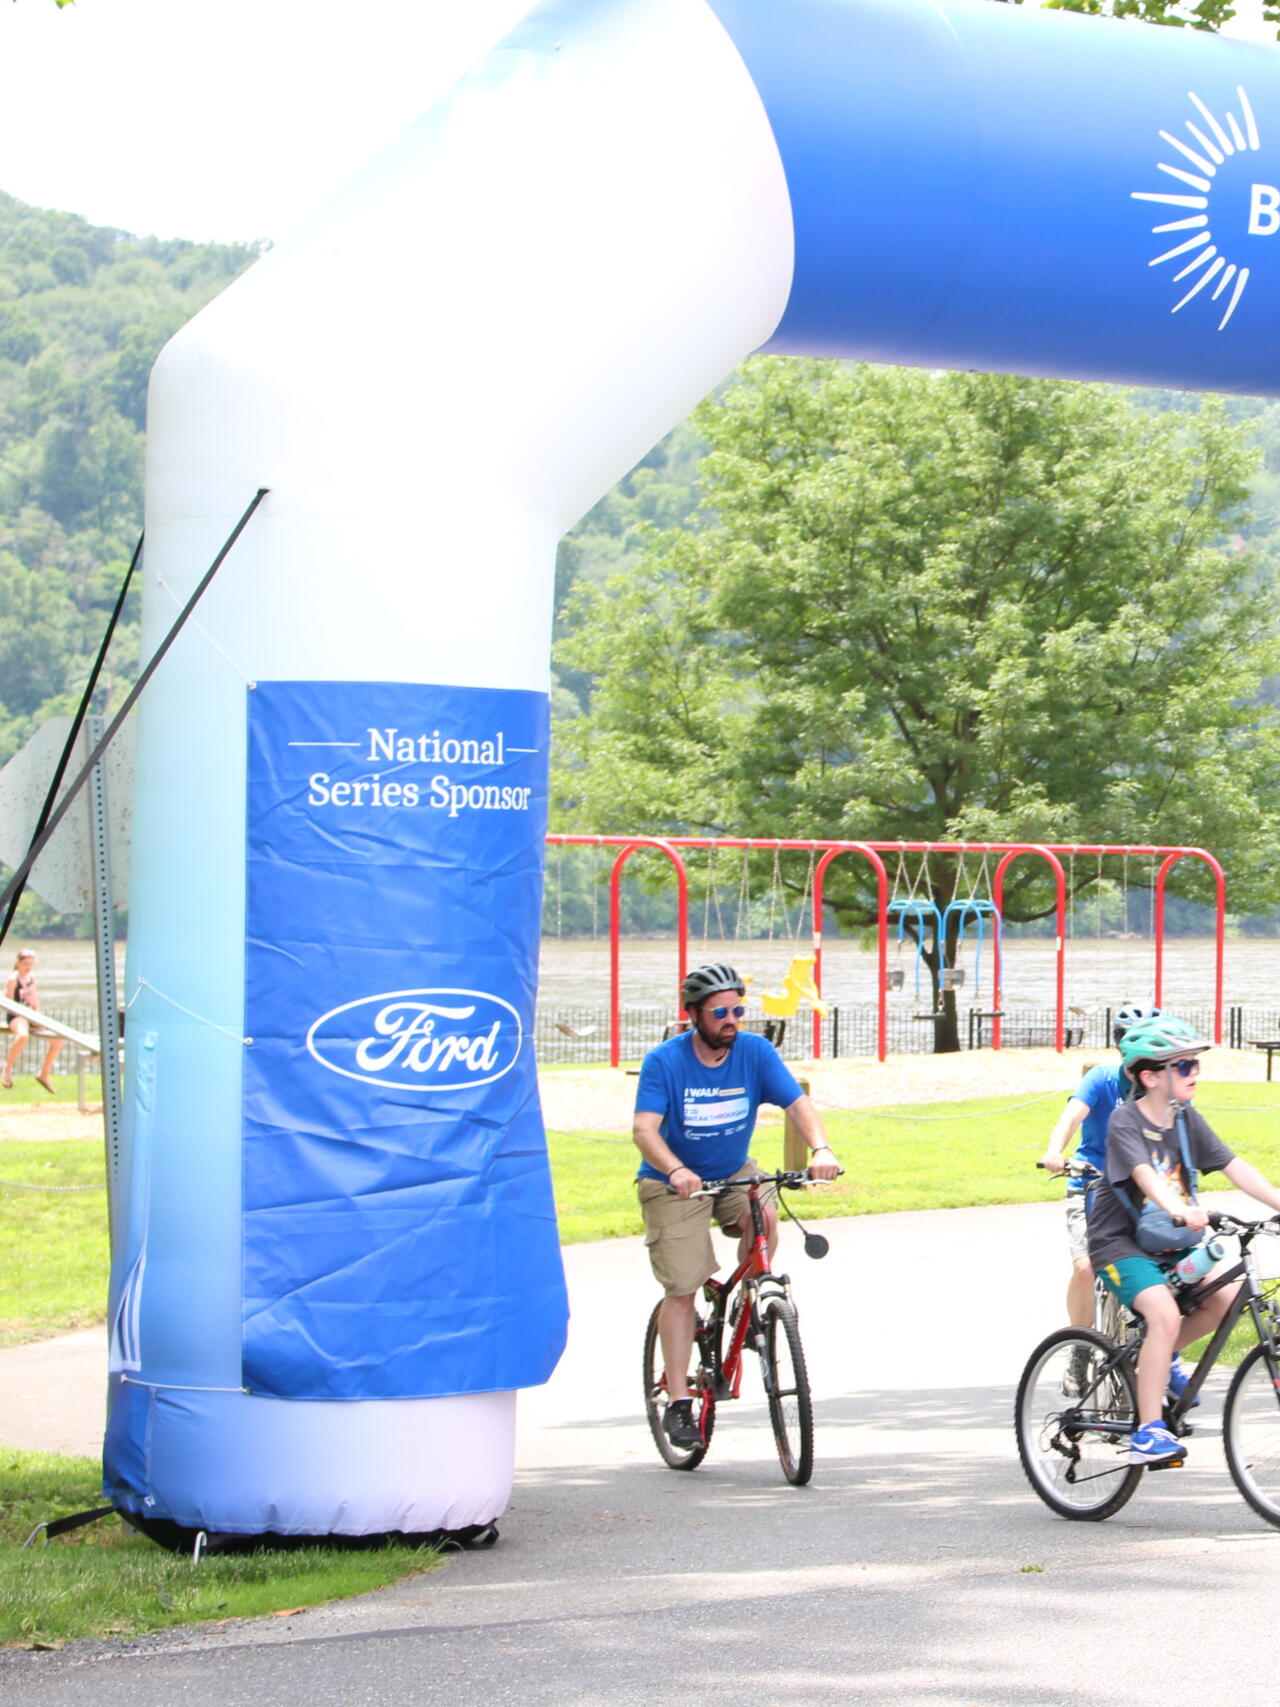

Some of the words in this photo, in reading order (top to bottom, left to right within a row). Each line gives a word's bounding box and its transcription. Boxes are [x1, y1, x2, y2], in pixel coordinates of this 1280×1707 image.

[366, 728, 504, 765] National
[308, 772, 419, 807] Series
[430, 775, 532, 818] Sponsor
[355, 1001, 501, 1072] Ford
